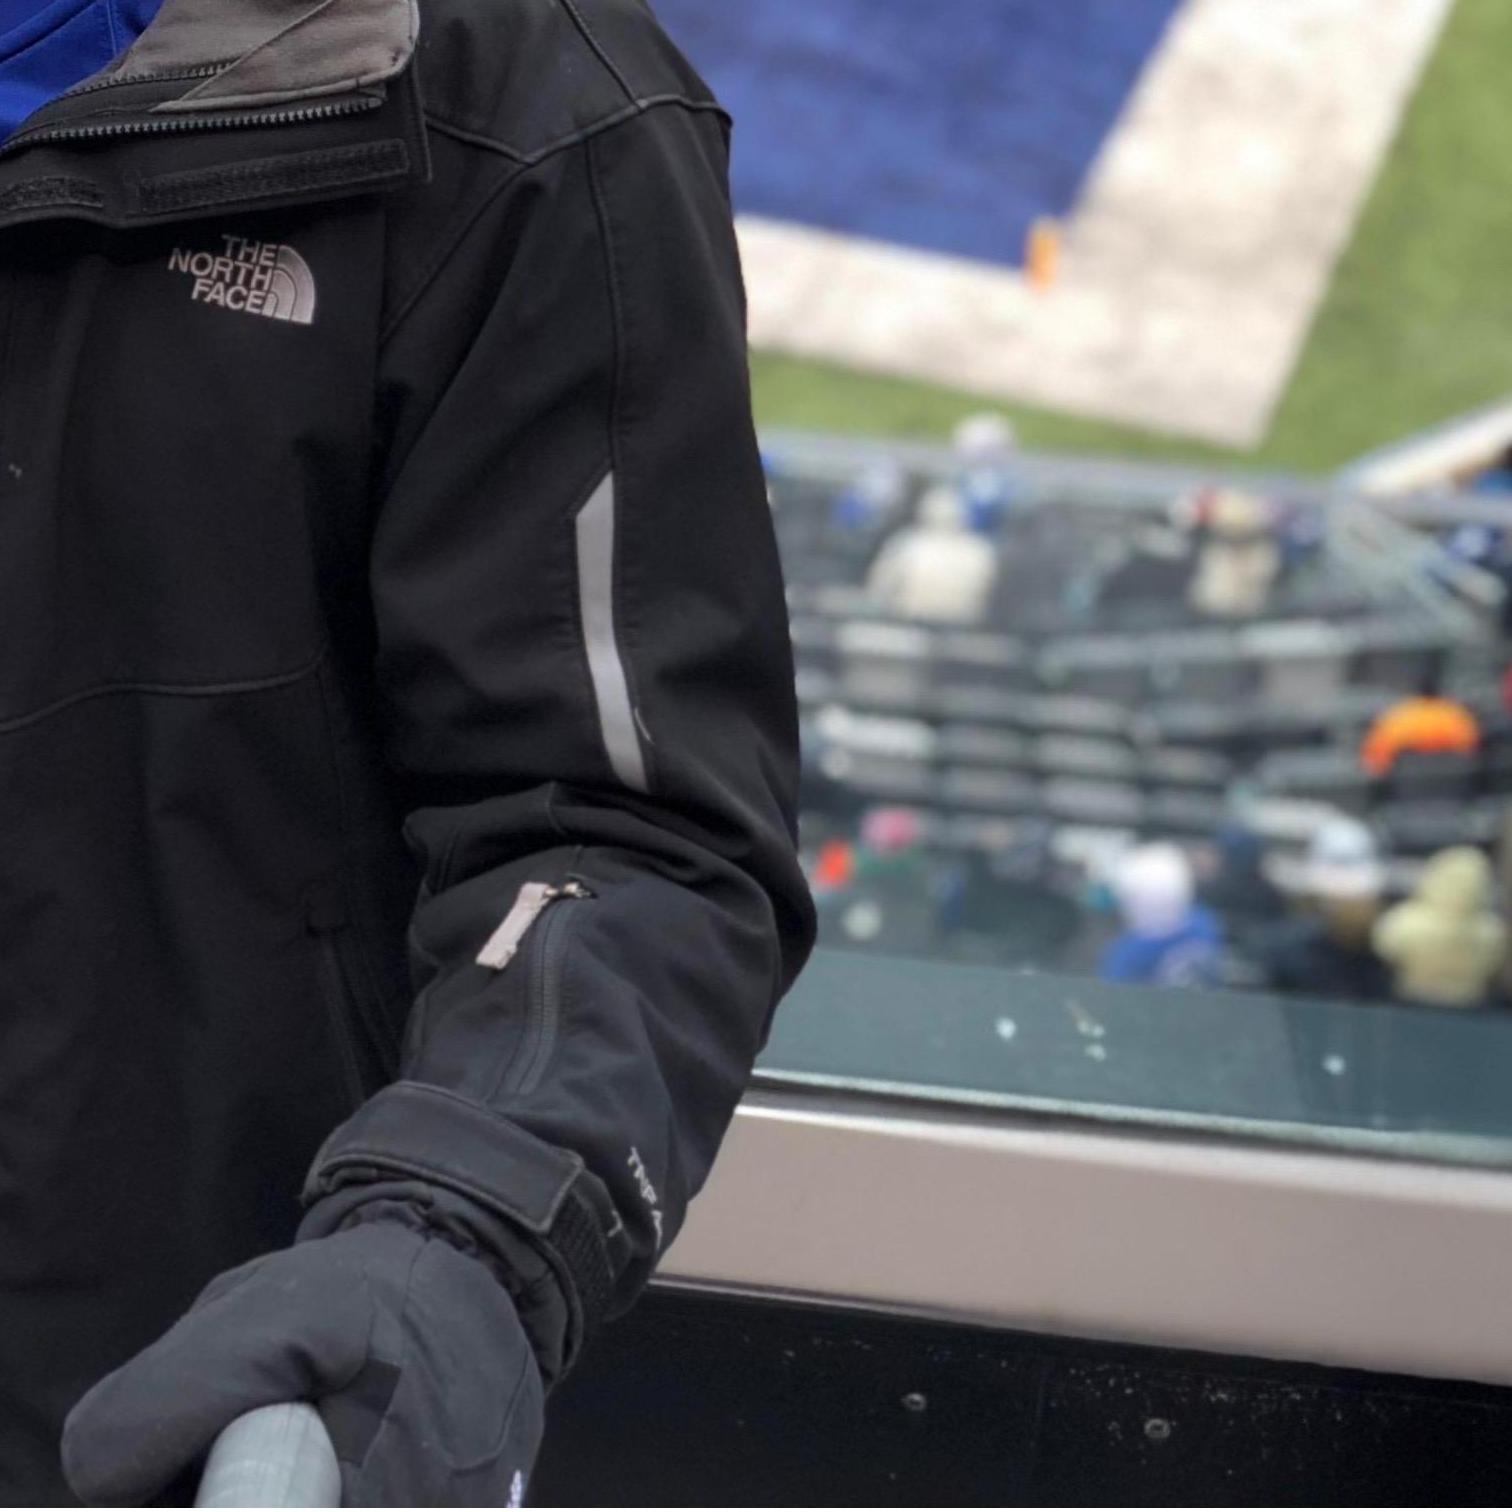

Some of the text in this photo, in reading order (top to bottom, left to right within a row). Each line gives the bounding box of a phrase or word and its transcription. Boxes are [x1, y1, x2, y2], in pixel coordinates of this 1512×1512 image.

[221, 234, 277, 266] THE
[168, 247, 273, 291] NORTH
[190, 278, 266, 314] FACE
